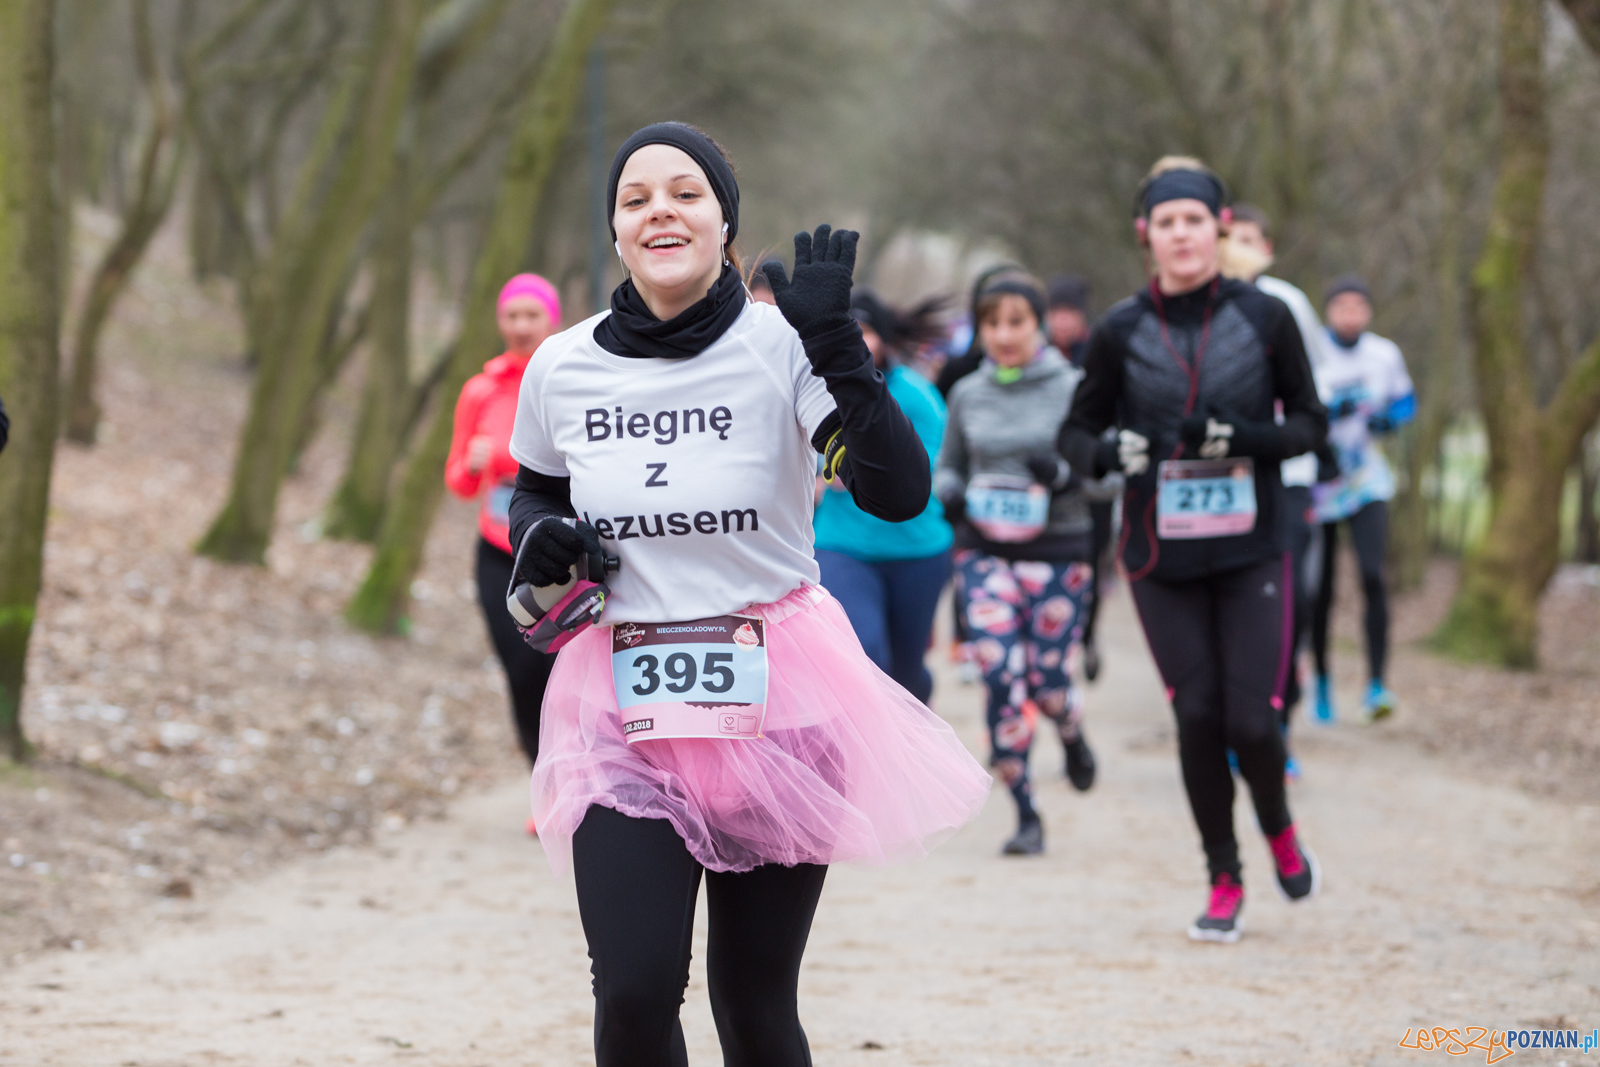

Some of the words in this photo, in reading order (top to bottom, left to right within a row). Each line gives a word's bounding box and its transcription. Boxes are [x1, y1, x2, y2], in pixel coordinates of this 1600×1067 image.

[585, 406, 733, 446] Biegnę
[645, 462, 668, 488] z
[656, 626, 727, 635] BIEGCZEKOLADOWY.PL
[631, 652, 735, 696] 395
